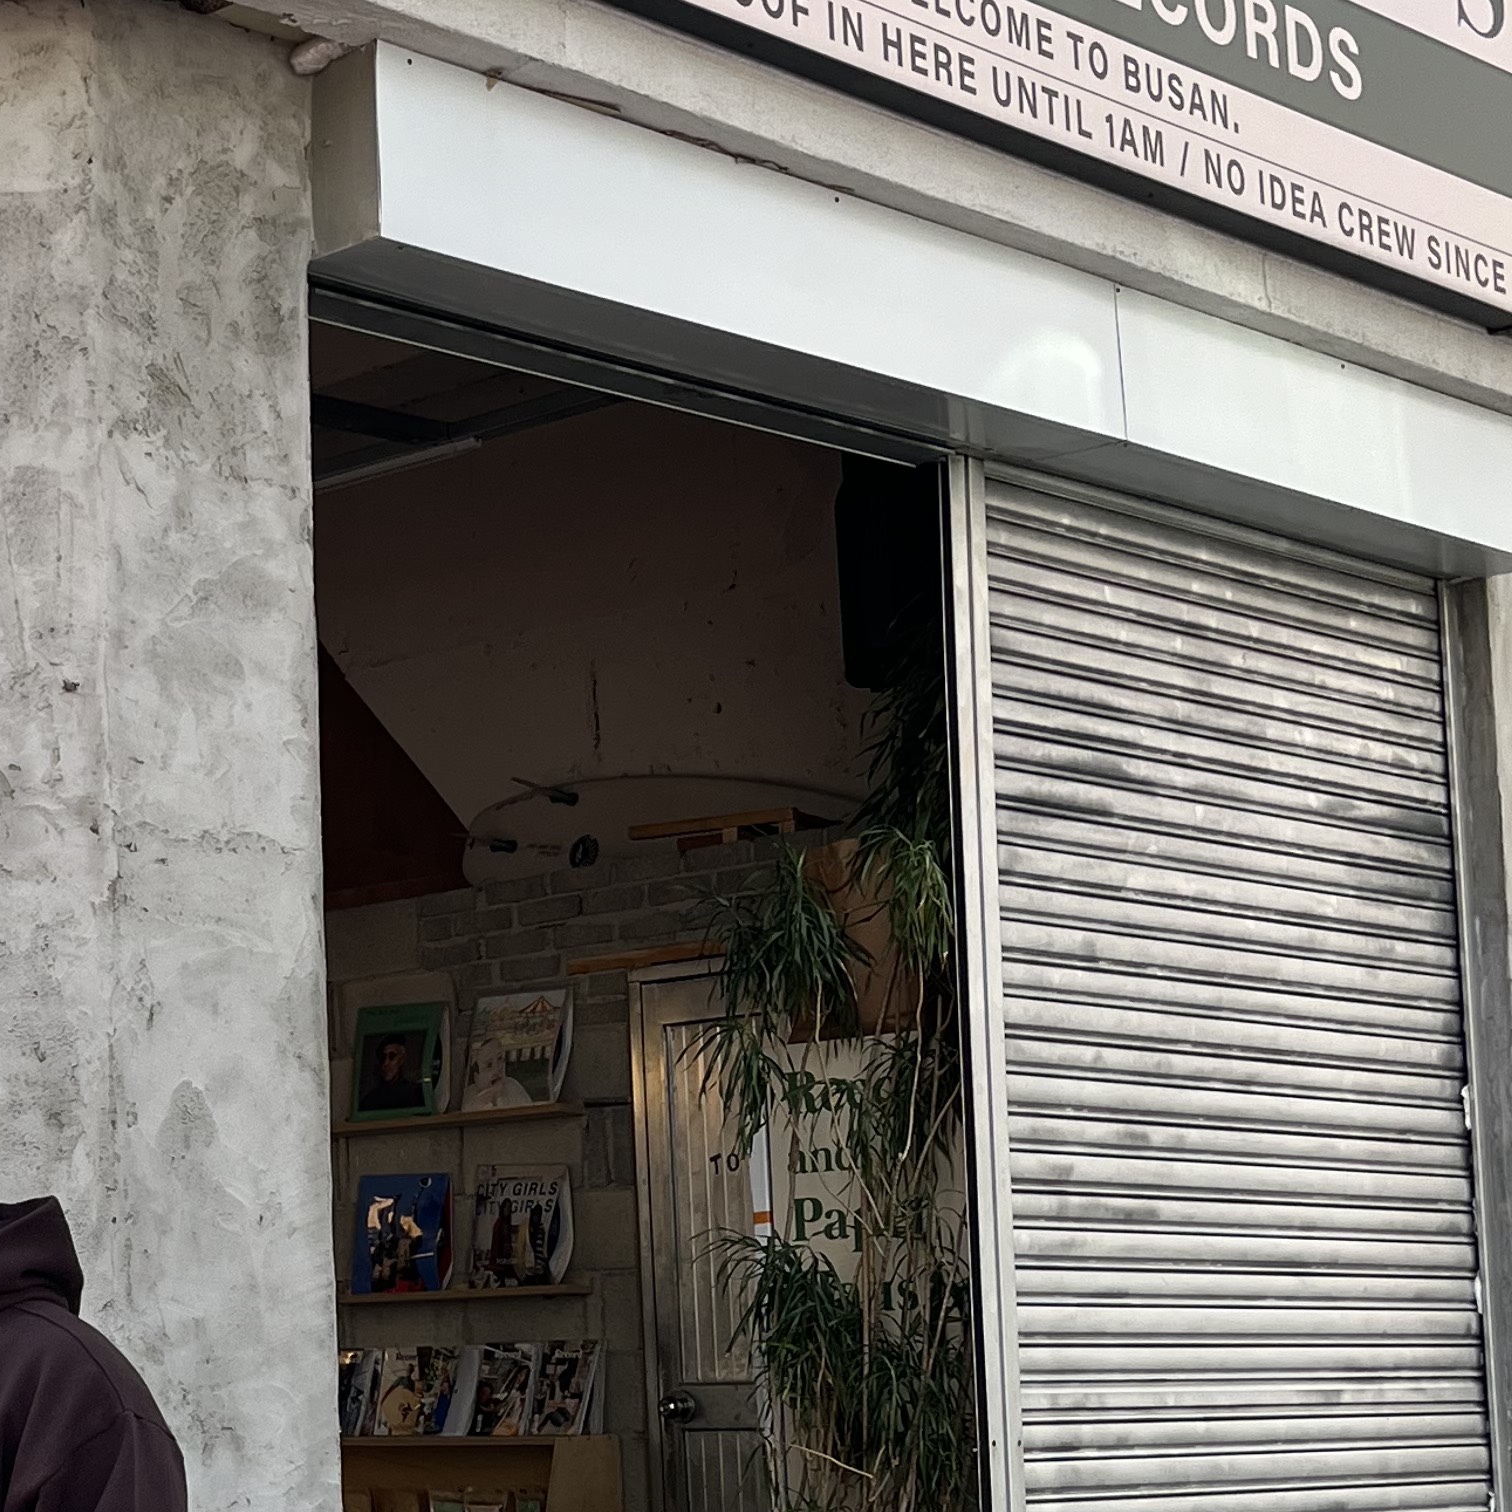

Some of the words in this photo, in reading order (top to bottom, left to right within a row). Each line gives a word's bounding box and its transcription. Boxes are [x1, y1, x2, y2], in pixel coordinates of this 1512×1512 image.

[1066, 31, 1109, 81] TO
[1122, 53, 1240, 134] BUSAN.
[828, 0, 864, 53] IN
[881, 22, 978, 96] HERE
[992, 65, 1093, 140] UNTIL
[1105, 113, 1165, 167] 1AM
[1180, 140, 1190, 177] /
[1203, 148, 1246, 196] NO
[1258, 169, 1328, 229] IDEA
[1338, 201, 1416, 261] CREW
[1427, 234, 1507, 295] SINCE
[512, 1182, 558, 1196] GIRLS
